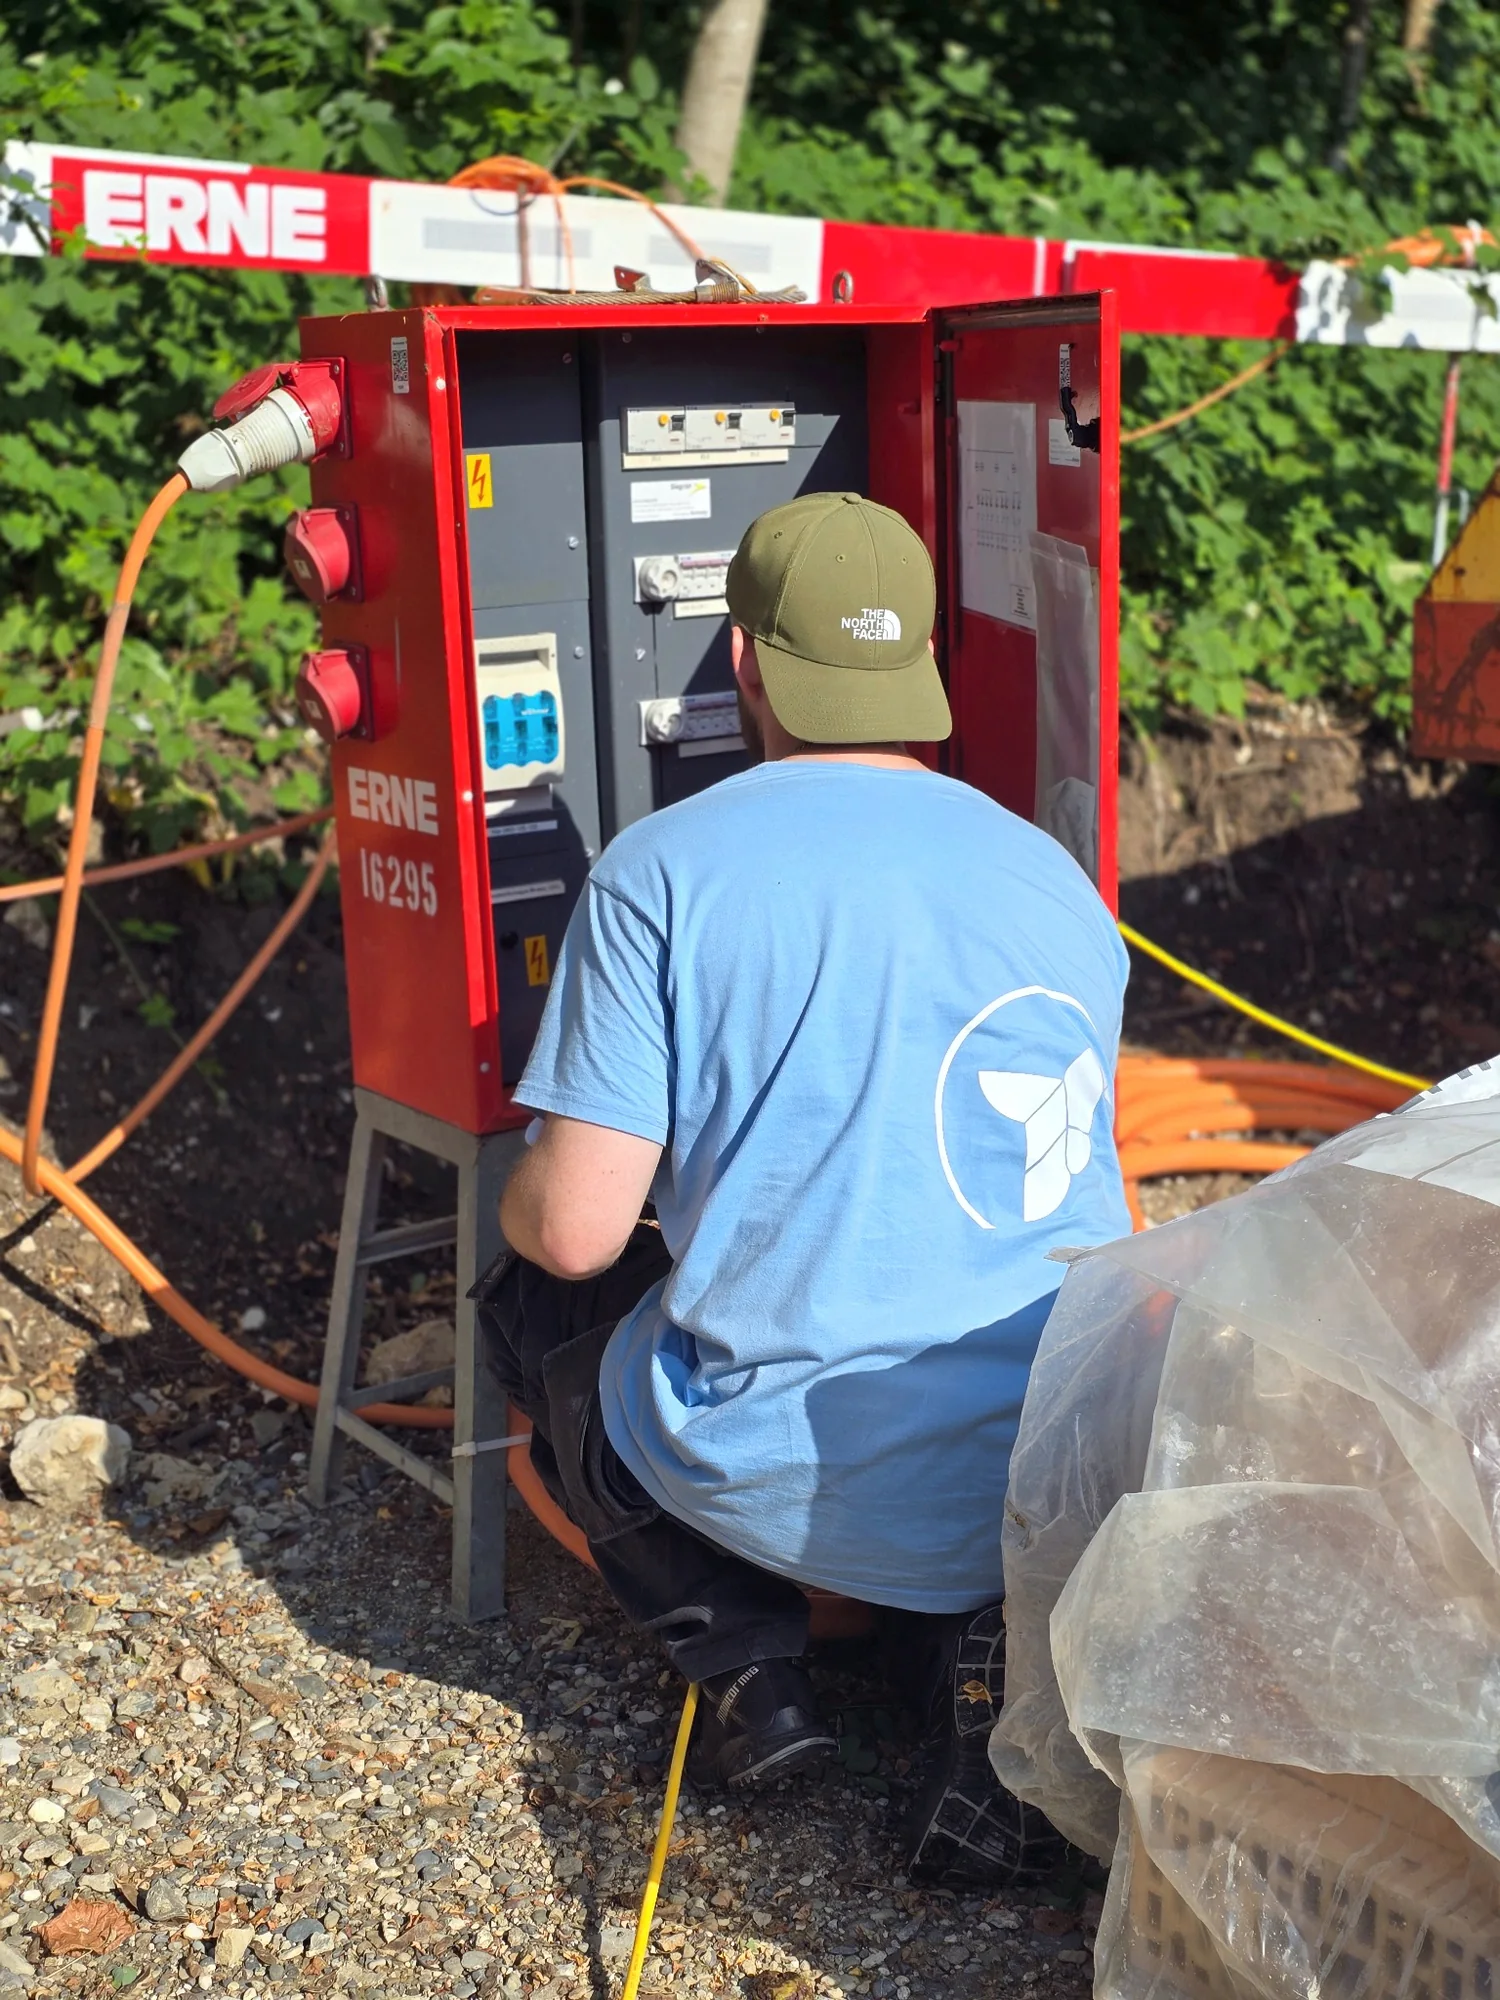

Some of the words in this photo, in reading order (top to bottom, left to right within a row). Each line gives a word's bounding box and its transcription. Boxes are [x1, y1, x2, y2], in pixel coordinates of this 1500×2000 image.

[83, 170, 326, 262] ERNE
[841, 617, 884, 631] NORTH
[853, 629, 884, 641] FACE
[861, 608, 885, 620] THE
[347, 766, 439, 836] ERNE
[360, 847, 438, 917] 16295
